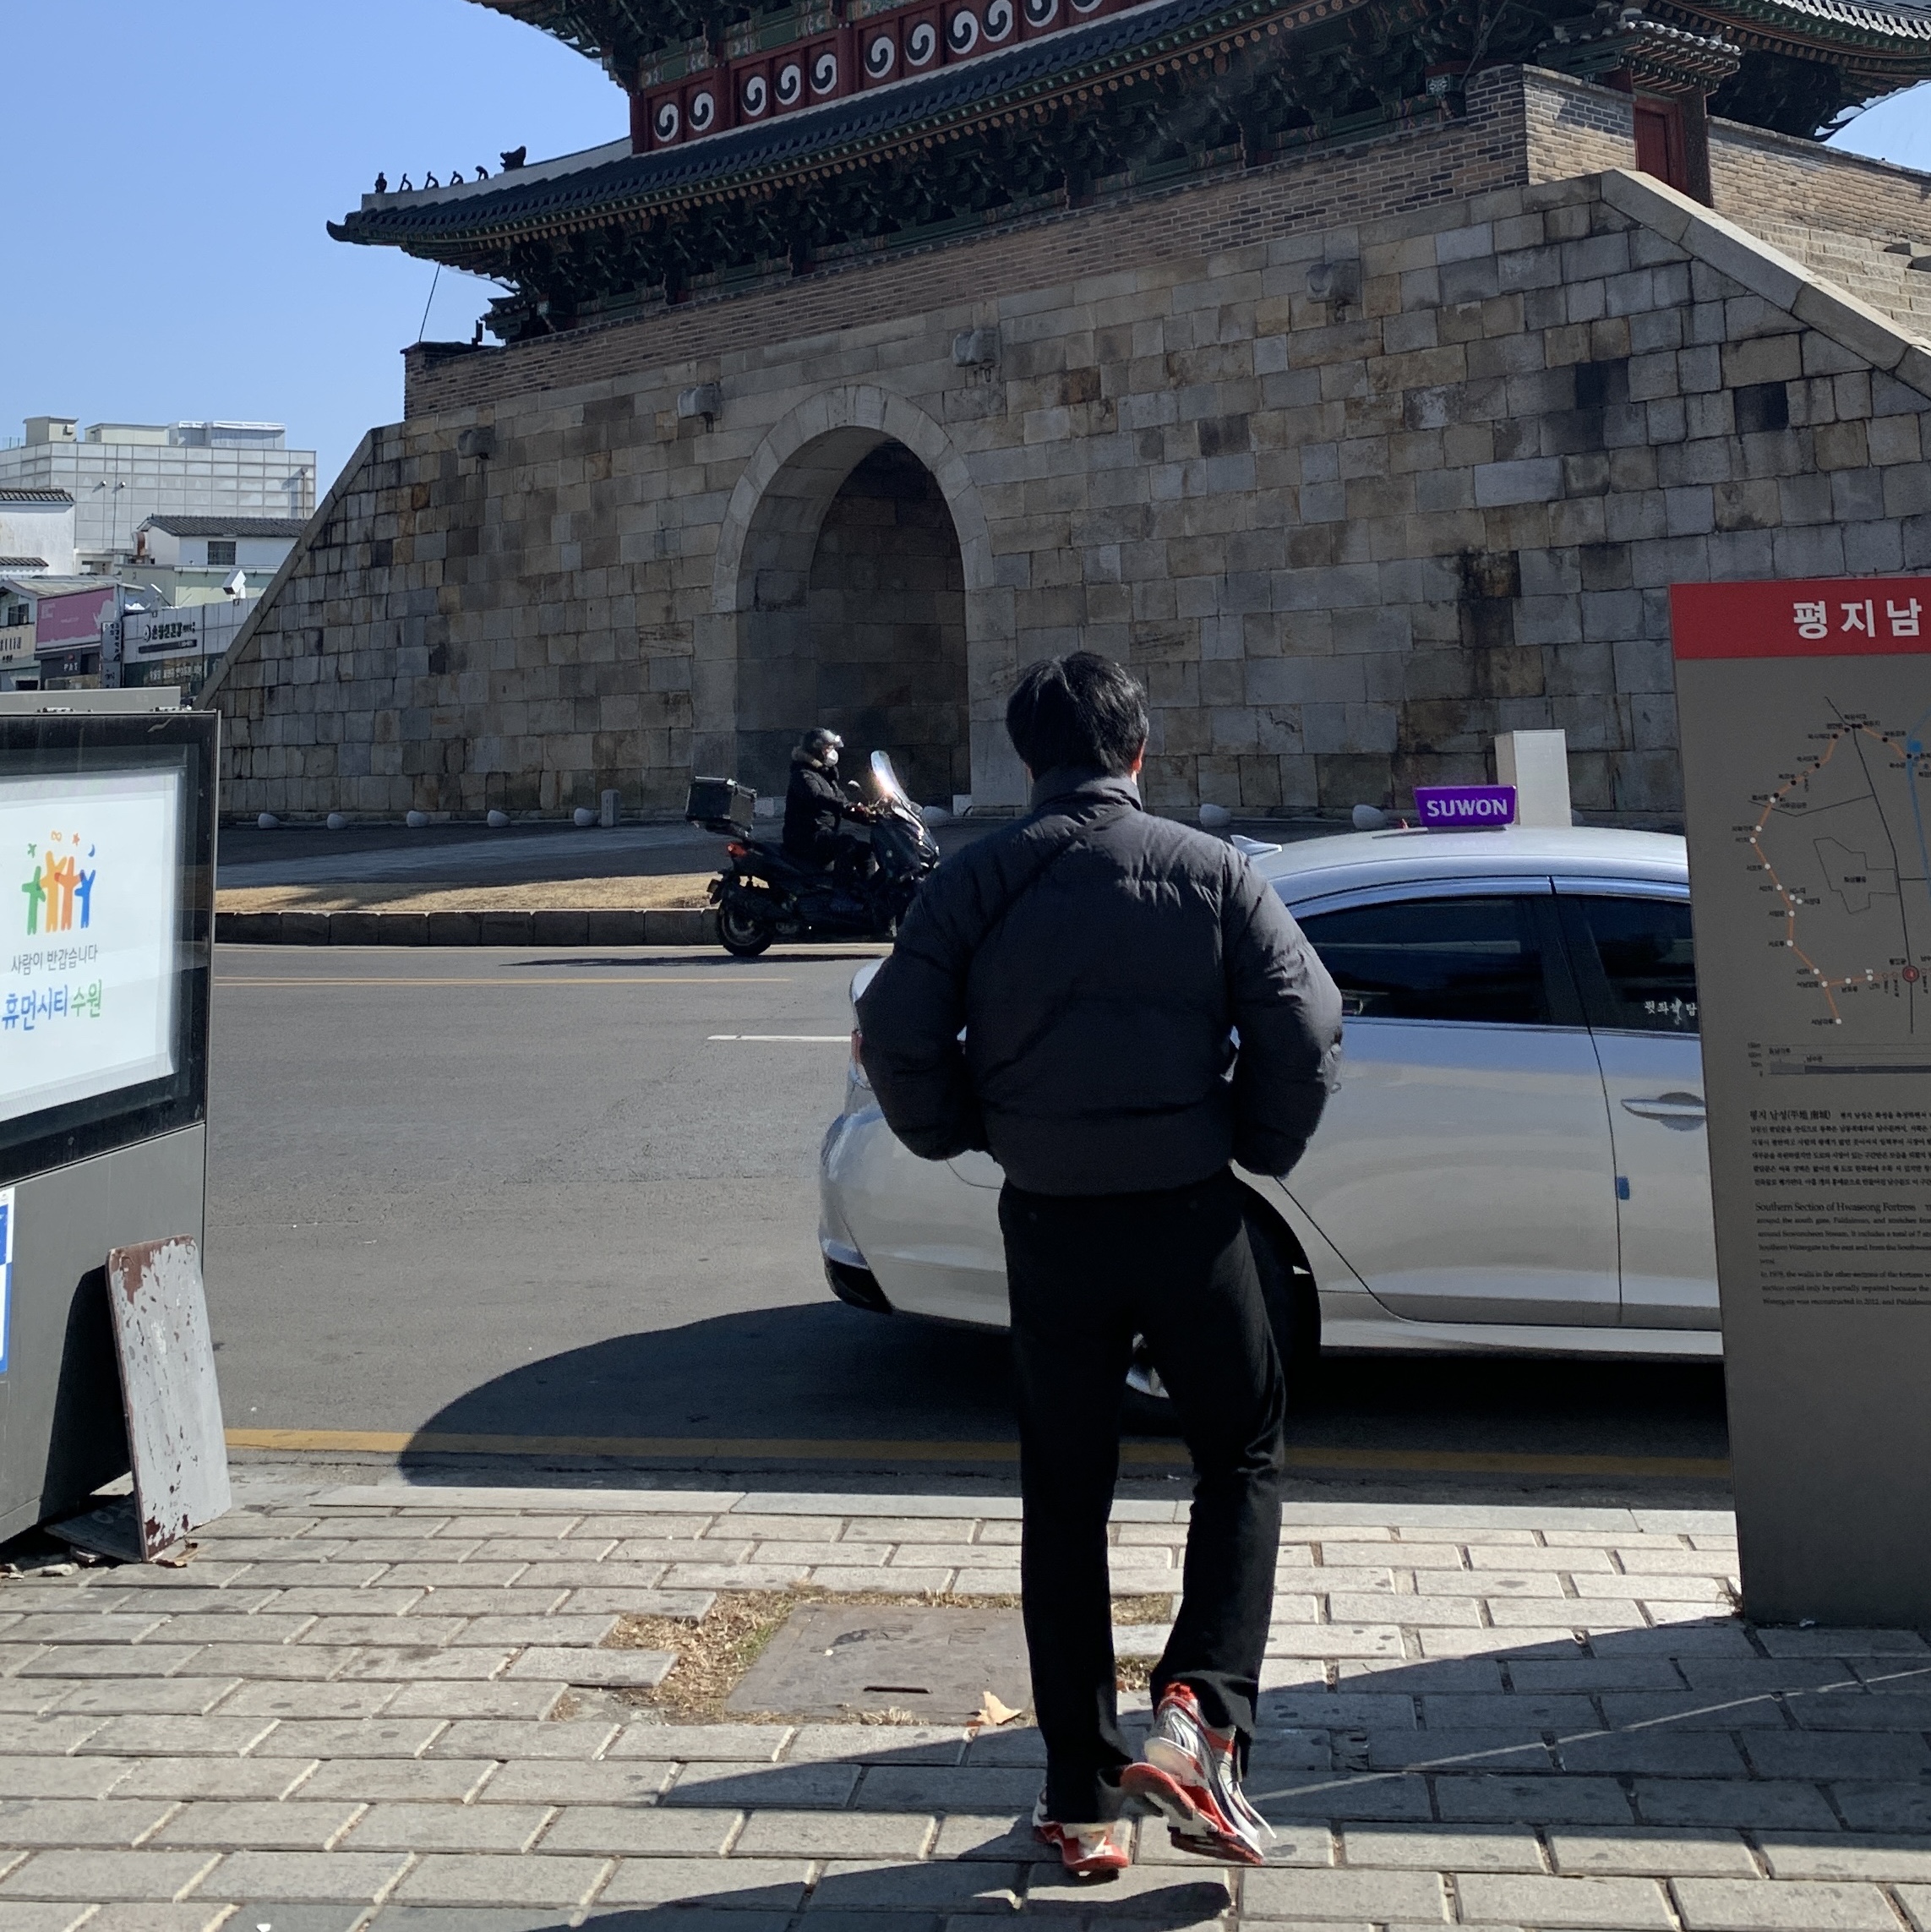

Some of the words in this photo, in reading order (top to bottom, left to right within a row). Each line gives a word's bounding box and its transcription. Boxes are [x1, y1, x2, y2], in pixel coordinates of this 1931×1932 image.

[1426, 799, 1508, 817] SUWON
[11, 951, 43, 975] 사람이
[47, 944, 98, 972] 반갑습니다
[2, 985, 68, 1031] 휴먼시티
[71, 980, 102, 1018] 수원
[1750, 1110, 1766, 1121] 평지
[1755, 1202, 1793, 1211] Southern
[1795, 1202, 1825, 1211] Section
[1836, 1202, 1881, 1214] Hwaseong
[1883, 1203, 1917, 1211] Fortress
